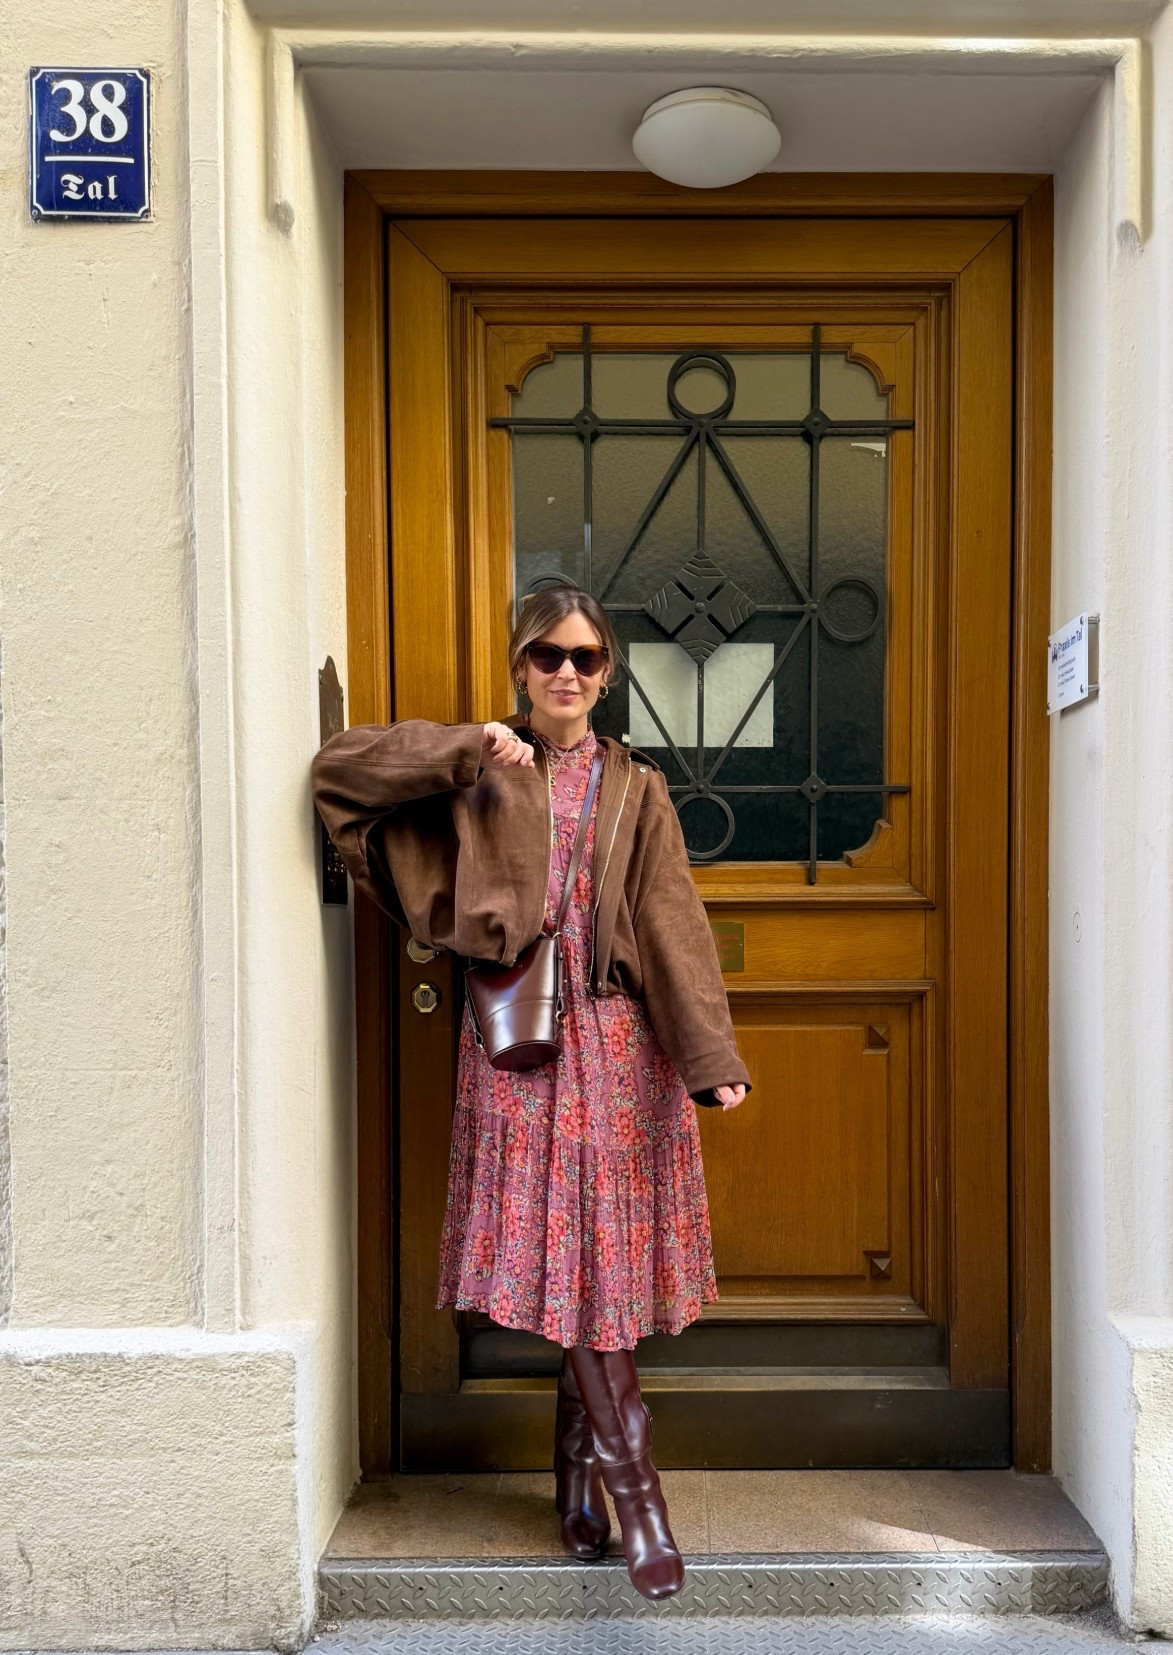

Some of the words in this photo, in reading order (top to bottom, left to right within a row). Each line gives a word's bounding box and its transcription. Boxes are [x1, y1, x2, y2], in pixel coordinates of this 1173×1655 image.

[49, 79, 128, 143] 38
[60, 173, 119, 201] Tal
[1058, 637, 1070, 654] Praxis
[1070, 635, 1076, 646] im
